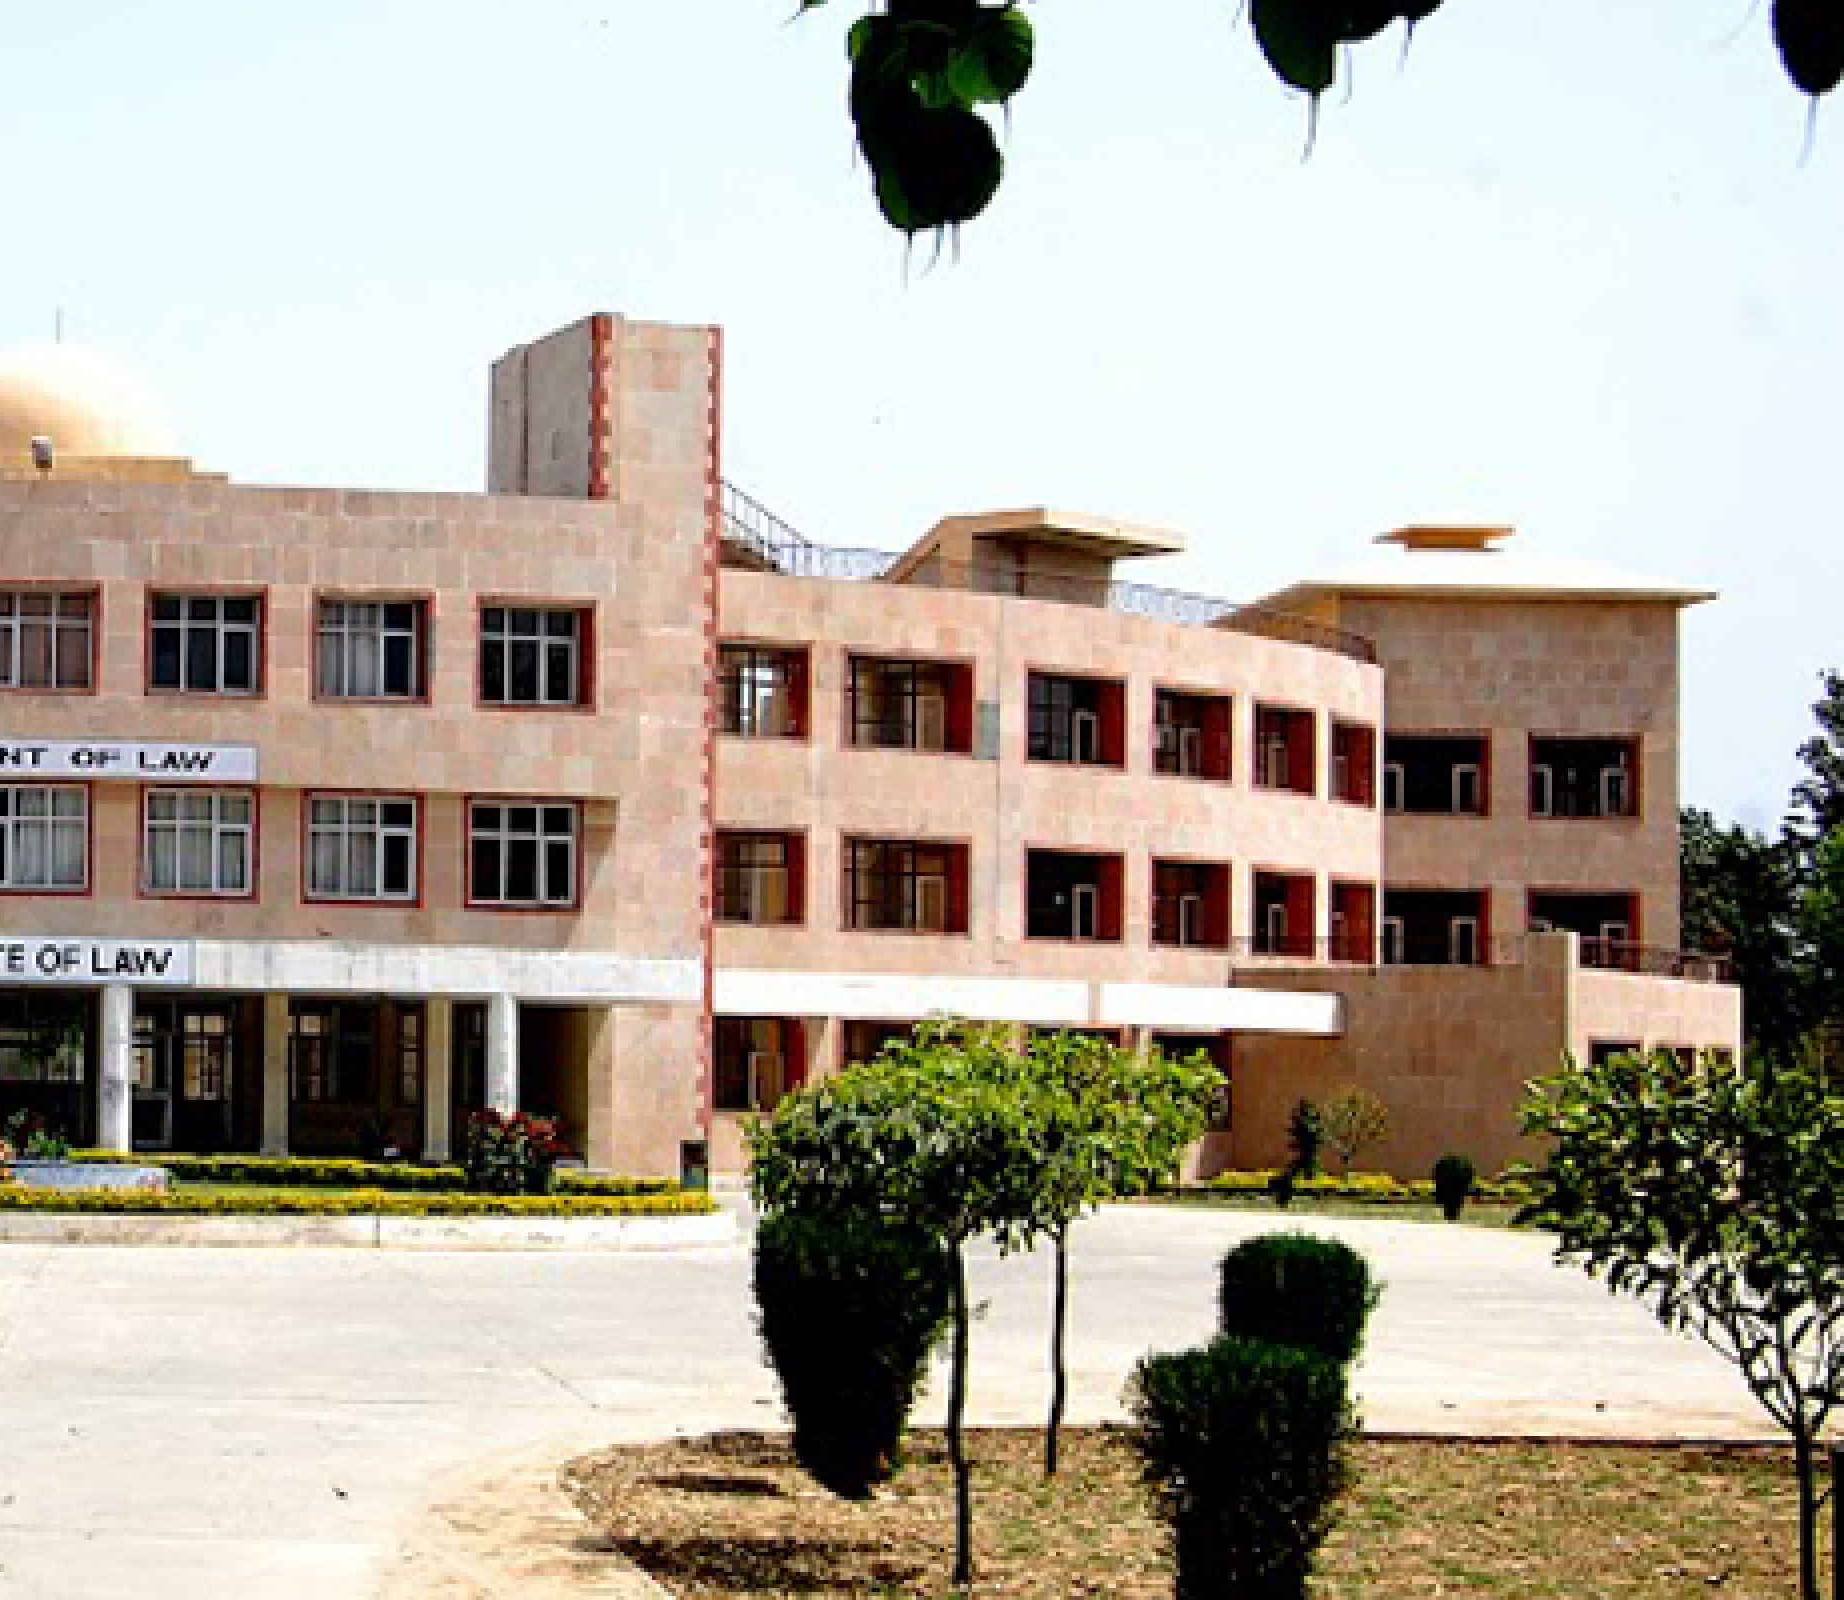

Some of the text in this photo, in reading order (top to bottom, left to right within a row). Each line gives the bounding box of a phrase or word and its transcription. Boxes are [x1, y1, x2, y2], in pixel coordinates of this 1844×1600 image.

[70, 747, 120, 768] OF
[139, 749, 214, 772] LAW
[35, 943, 82, 973] OF
[91, 946, 173, 977] LAW
